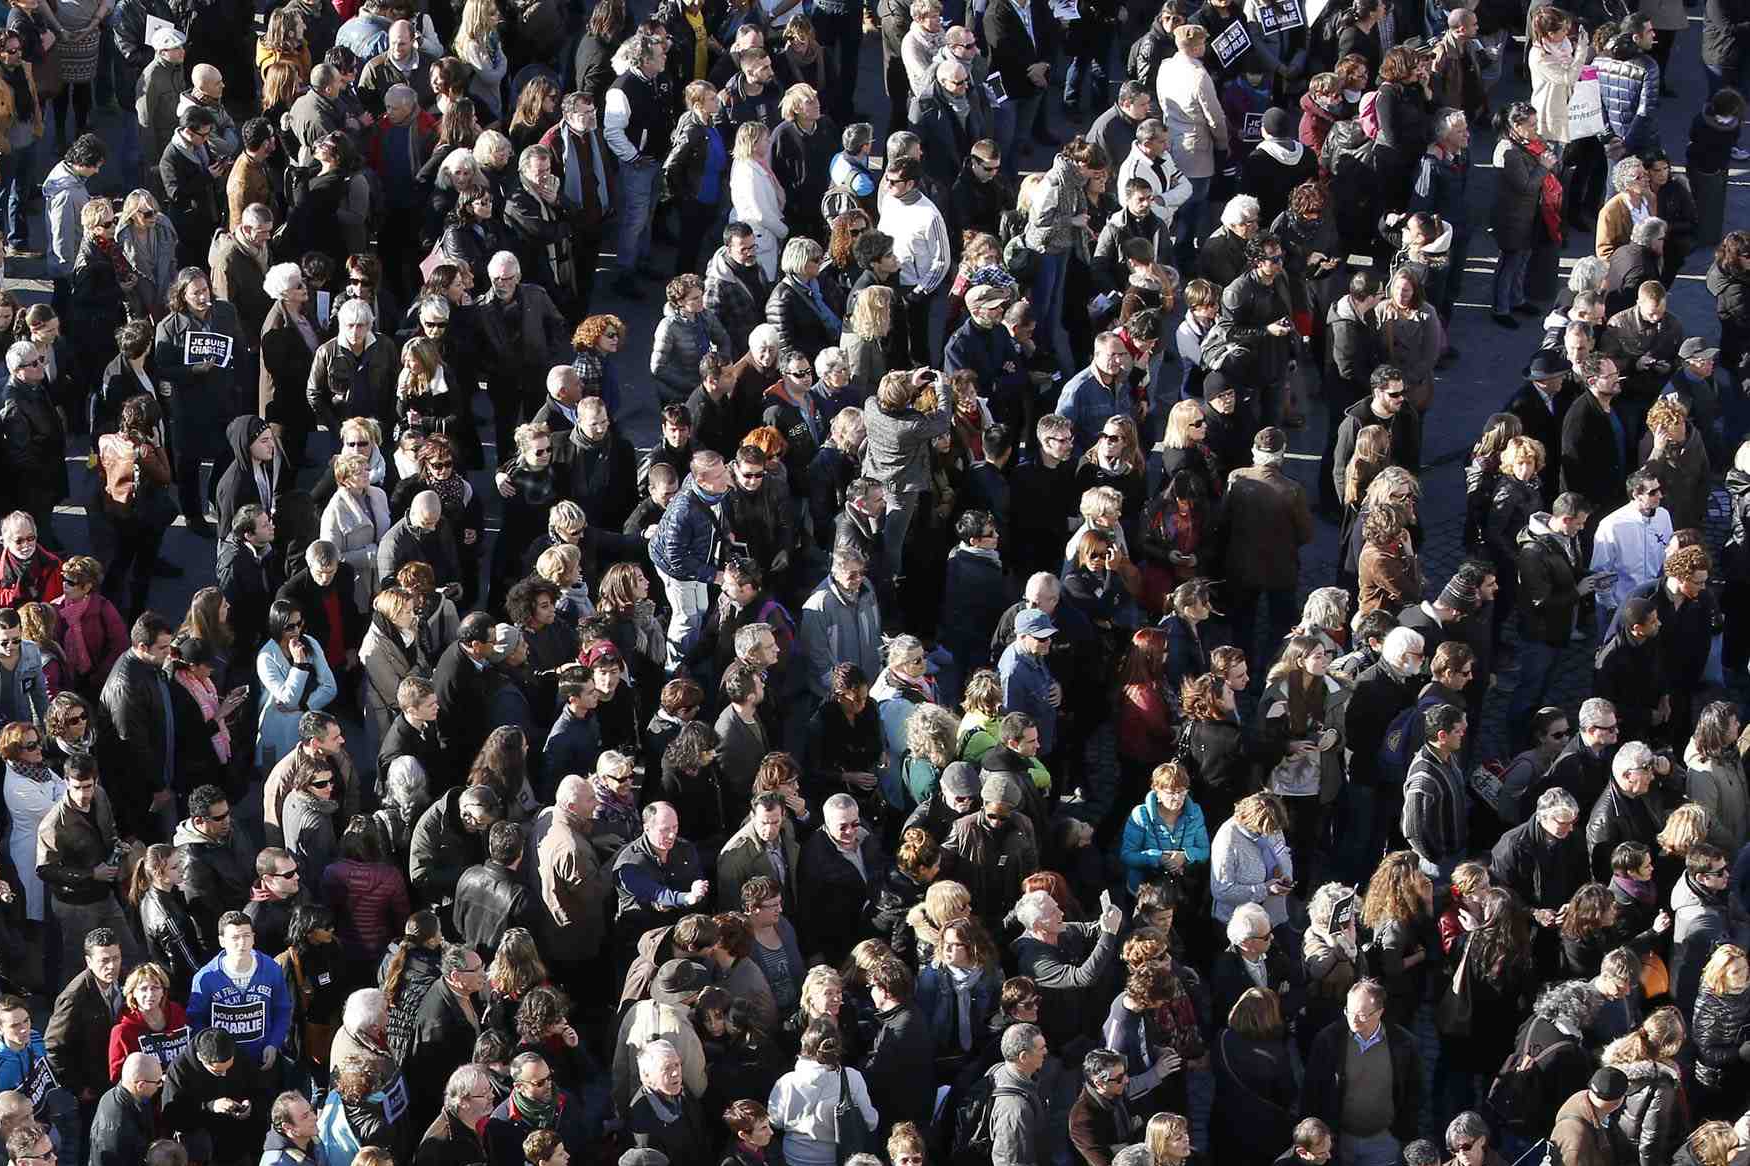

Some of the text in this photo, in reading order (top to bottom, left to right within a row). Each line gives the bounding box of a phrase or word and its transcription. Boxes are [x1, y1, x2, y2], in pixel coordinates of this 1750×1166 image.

[191, 338, 226, 348] JE SUIS
[190, 346, 225, 357] CHARLIE
[214, 1010, 262, 1020] NOUS SOMMES
[214, 1019, 262, 1034] CHARLIE
[30, 1071, 52, 1104] ARLIE
